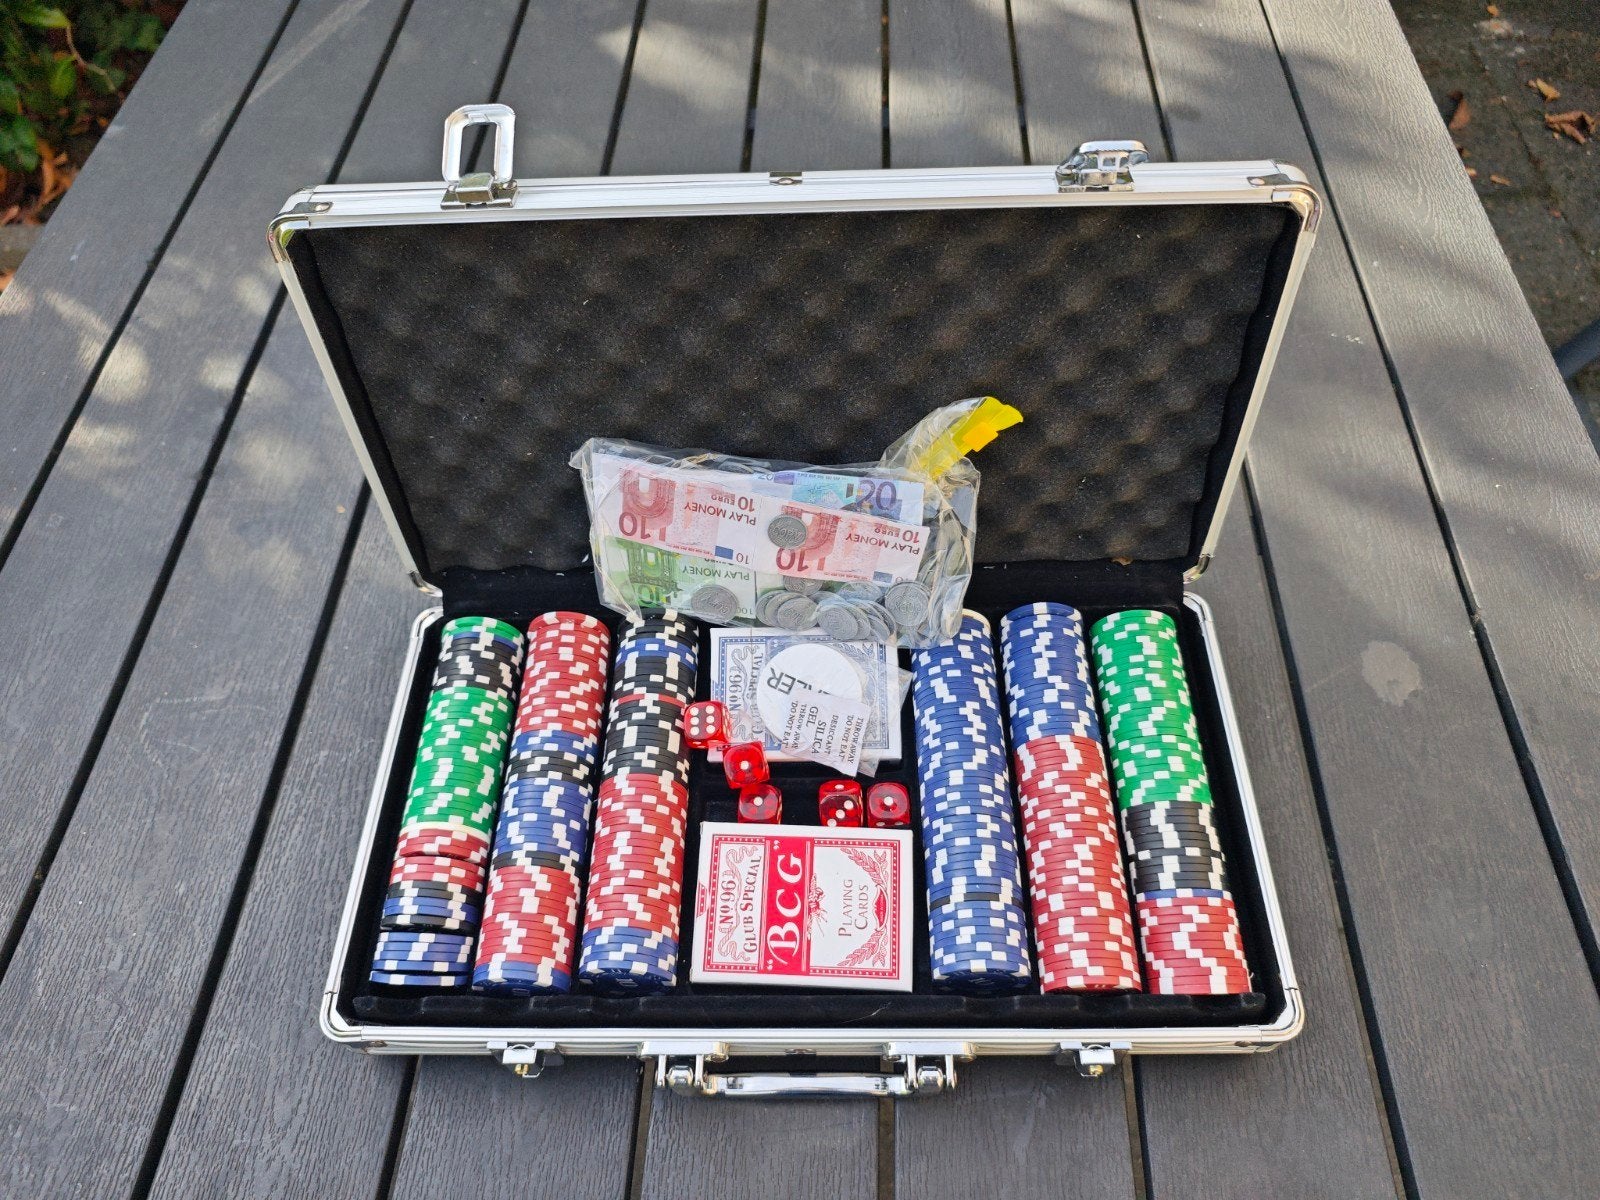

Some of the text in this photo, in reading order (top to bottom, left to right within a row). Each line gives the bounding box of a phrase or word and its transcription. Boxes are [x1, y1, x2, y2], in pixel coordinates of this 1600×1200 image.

[711, 494, 755, 513] 10 EURO
[856, 480, 897, 511] 20
[619, 512, 651, 539] 10
[684, 503, 756, 526] PLAY MONEY
[845, 532, 920, 555] PLAY MONEY
[874, 527, 920, 544] 10 EURO
[736, 552, 750, 565] 10
[775, 547, 809, 572] 10
[682, 565, 750, 581] PLAY MONEY
[728, 672, 743, 694] 96
[786, 714, 795, 730] NOT
[806, 706, 819, 727] GEL
[811, 720, 827, 754] SILICA
[824, 714, 839, 754] DESICCANT
[842, 727, 851, 743] NOT
[848, 744, 857, 764] AWAY
[721, 879, 737, 902] 96
[739, 855, 762, 953] GLUB SPECIAL
[838, 879, 853, 937] PLAYING
[854, 884, 869, 931] CARDS
